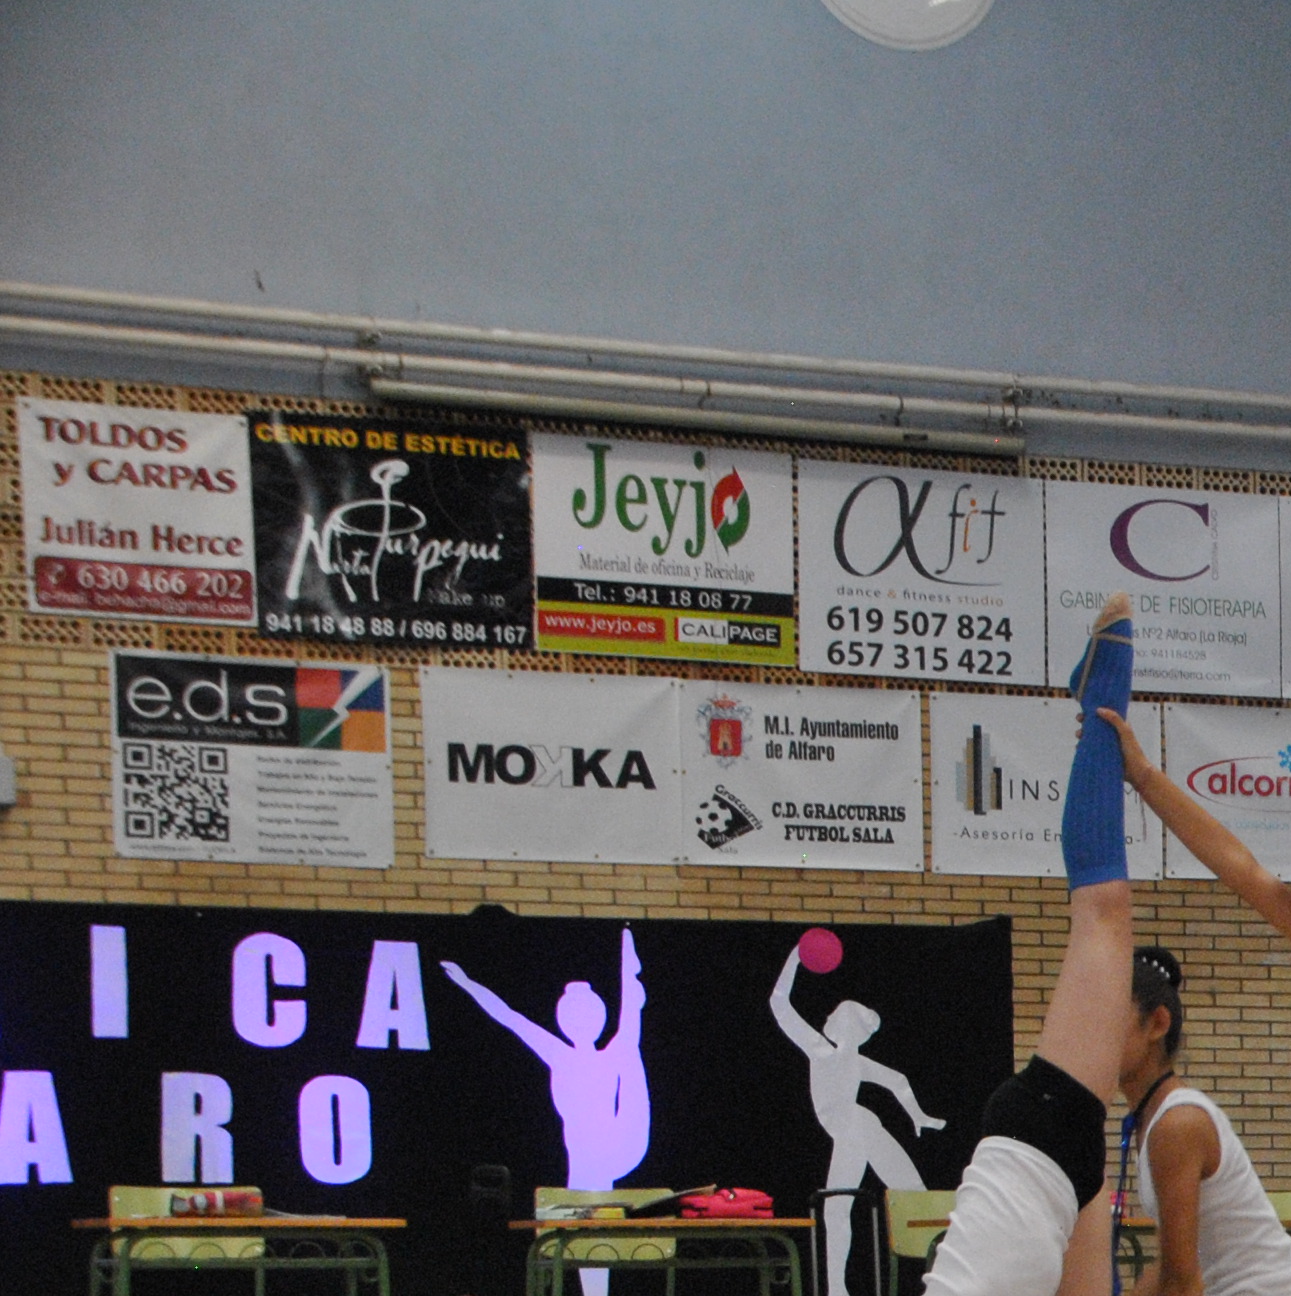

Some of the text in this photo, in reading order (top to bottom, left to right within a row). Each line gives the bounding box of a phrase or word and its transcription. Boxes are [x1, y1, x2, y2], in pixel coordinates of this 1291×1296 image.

[38, 416, 188, 453] TOLDOS
[254, 422, 359, 449] CENTRO
[365, 430, 398, 451] DE
[53, 459, 238, 494] y CARPAS
[40, 516, 244, 557] Julián Herce
[578, 552, 755, 584] Material de oficina y Reciclaje
[77, 564, 244, 600] 630 466 202
[624, 586, 659, 605] 941
[669, 589, 692, 608] 18
[699, 591, 723, 610] 08
[729, 593, 753, 612] 77
[836, 584, 881, 598] dance
[902, 588, 951, 602] fitness
[957, 595, 1004, 608] studio
[1140, 595, 1161, 614] DE
[1169, 597, 1267, 619] FISIOTERAPIA
[265, 613, 301, 634] 941
[311, 614, 336, 635] 18
[340, 616, 366, 637] 48
[371, 618, 396, 638] 88
[411, 620, 448, 640] 696
[452, 622, 488, 643] 884
[493, 625, 527, 645] 167
[544, 614, 657, 634] www.jeyjo.es
[826, 605, 1014, 643] 619 507 824
[1166, 628, 1198, 641] Alfaro
[826, 640, 1013, 676] 657 315 422
[764, 715, 899, 740] M.I. Ayuntamiento
[765, 739, 835, 762] de Alfaro
[771, 801, 907, 823] C.D. GRACCURRIS
[783, 824, 895, 844] FUTBOL SALA
